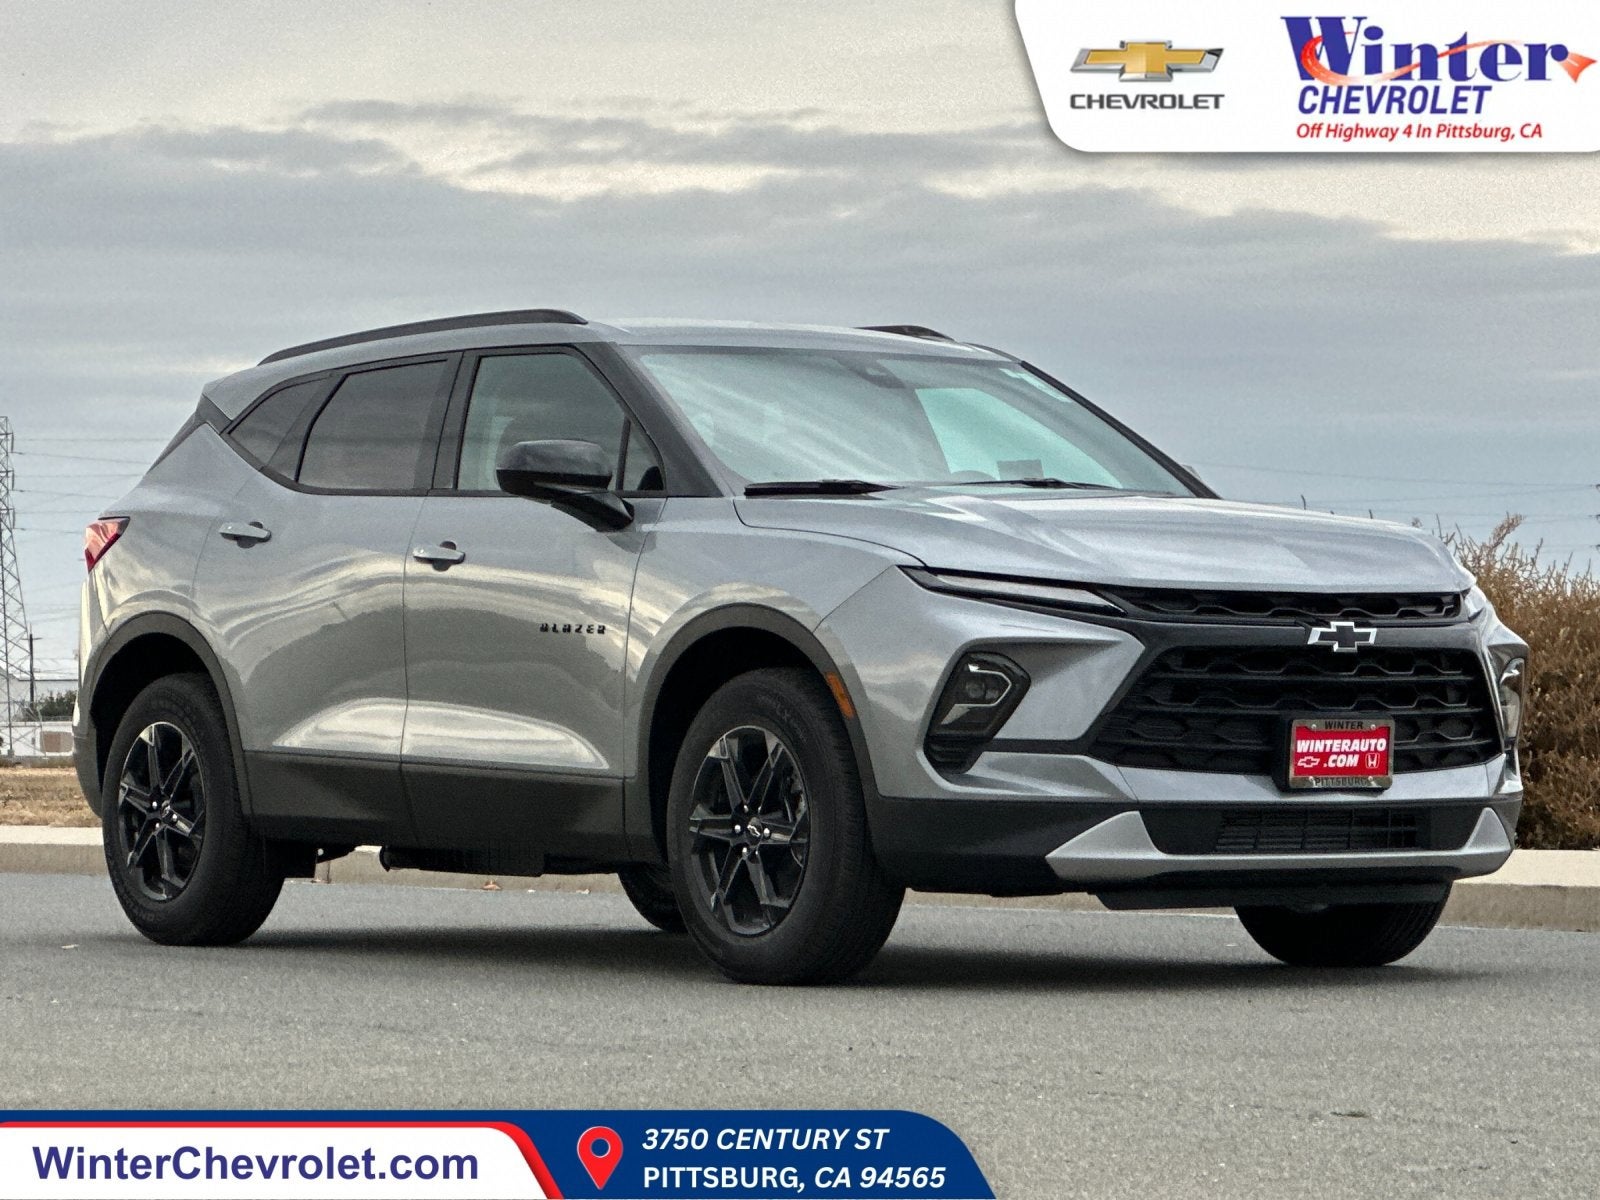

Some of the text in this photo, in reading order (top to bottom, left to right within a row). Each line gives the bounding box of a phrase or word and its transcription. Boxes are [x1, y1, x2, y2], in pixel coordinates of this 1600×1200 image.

[540, 623, 606, 634] BLAZER
[1324, 721, 1364, 729] WINTER
[1296, 738, 1387, 753] WINTERAUTO
[1323, 754, 1360, 768] .COM
[1315, 777, 1367, 788] PITTSBURG
